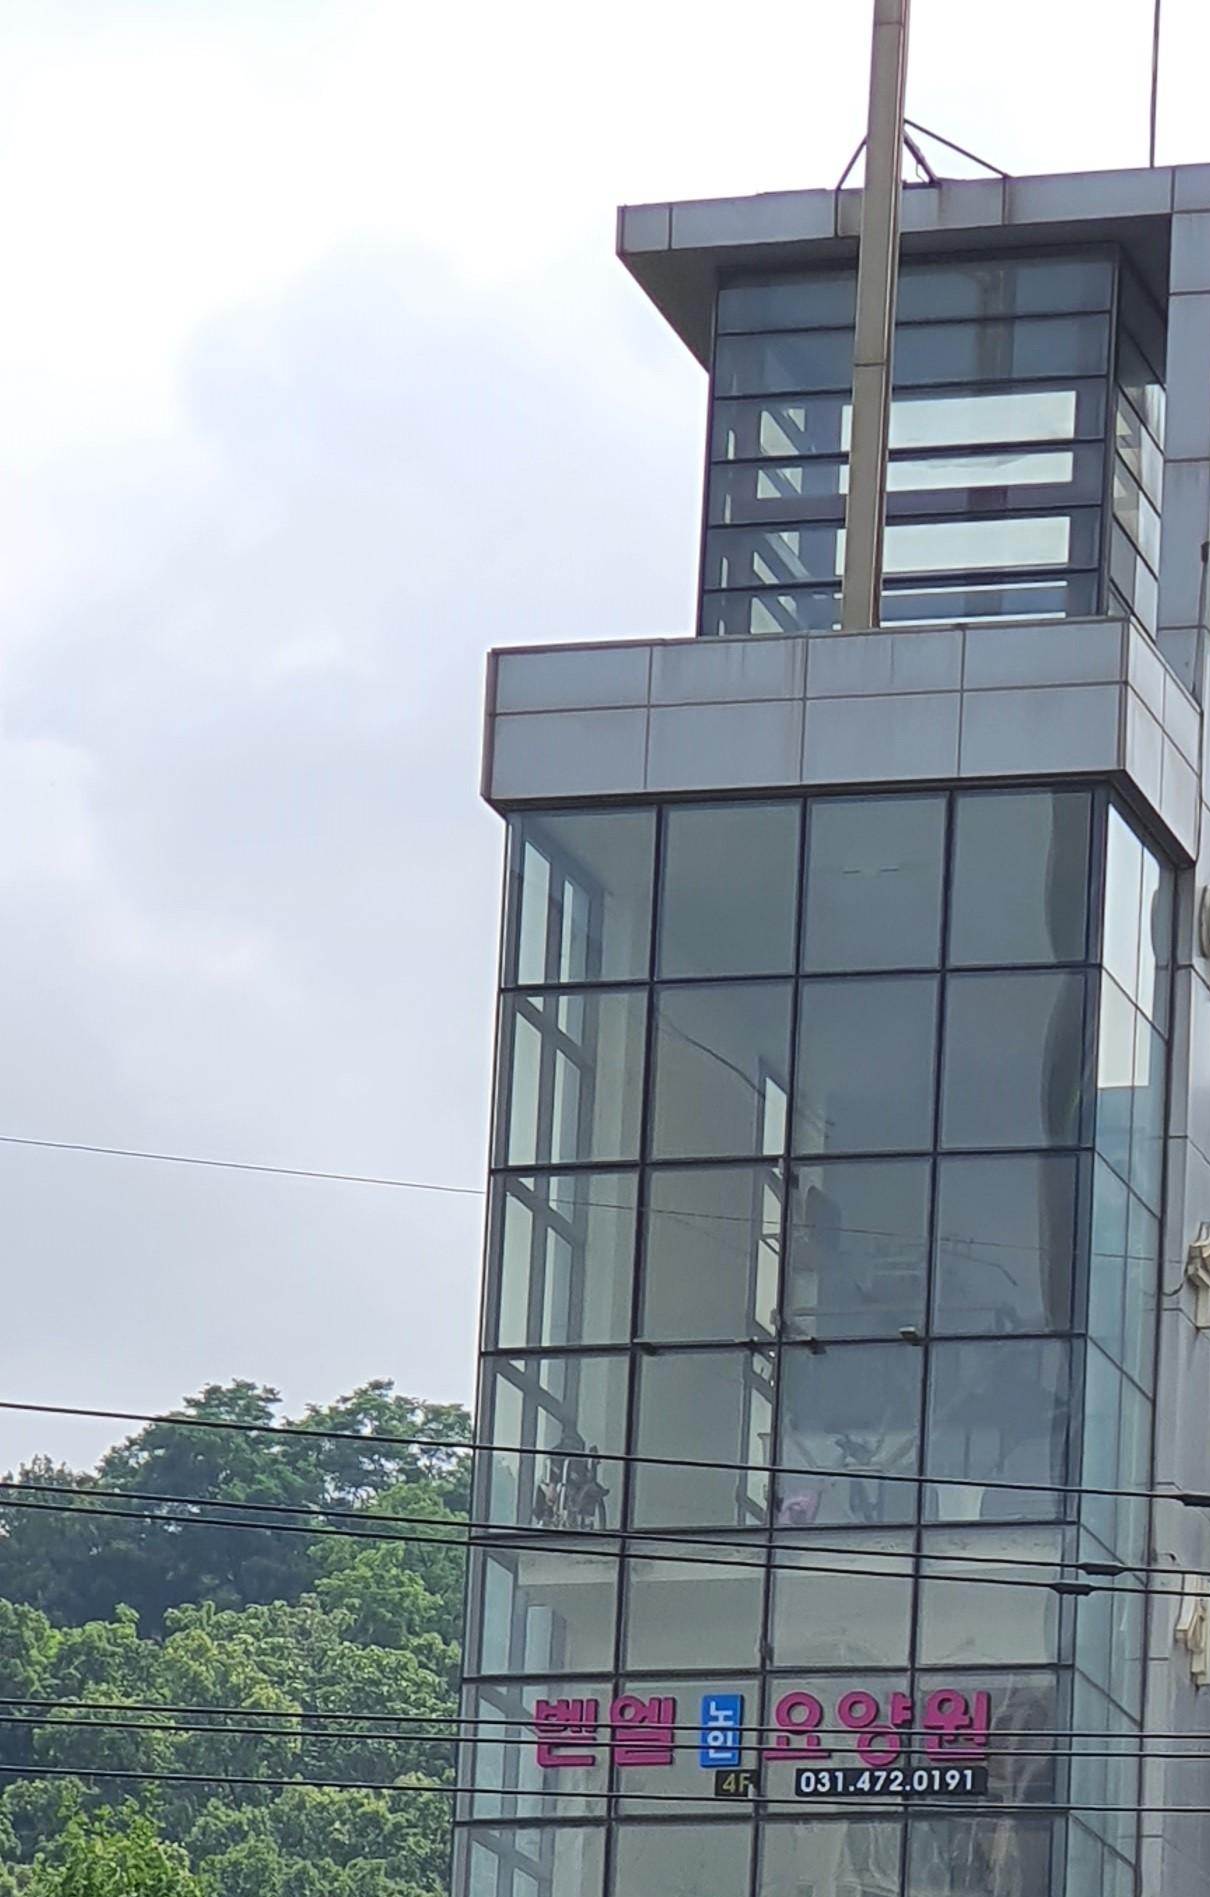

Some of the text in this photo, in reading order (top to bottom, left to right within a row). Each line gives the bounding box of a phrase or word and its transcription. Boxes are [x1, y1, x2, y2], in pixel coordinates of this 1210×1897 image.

[708, 1702, 733, 1758] 노인
[763, 1690, 990, 1768] 요양원
[722, 1769, 974, 1793] 4F 031.472.0191
